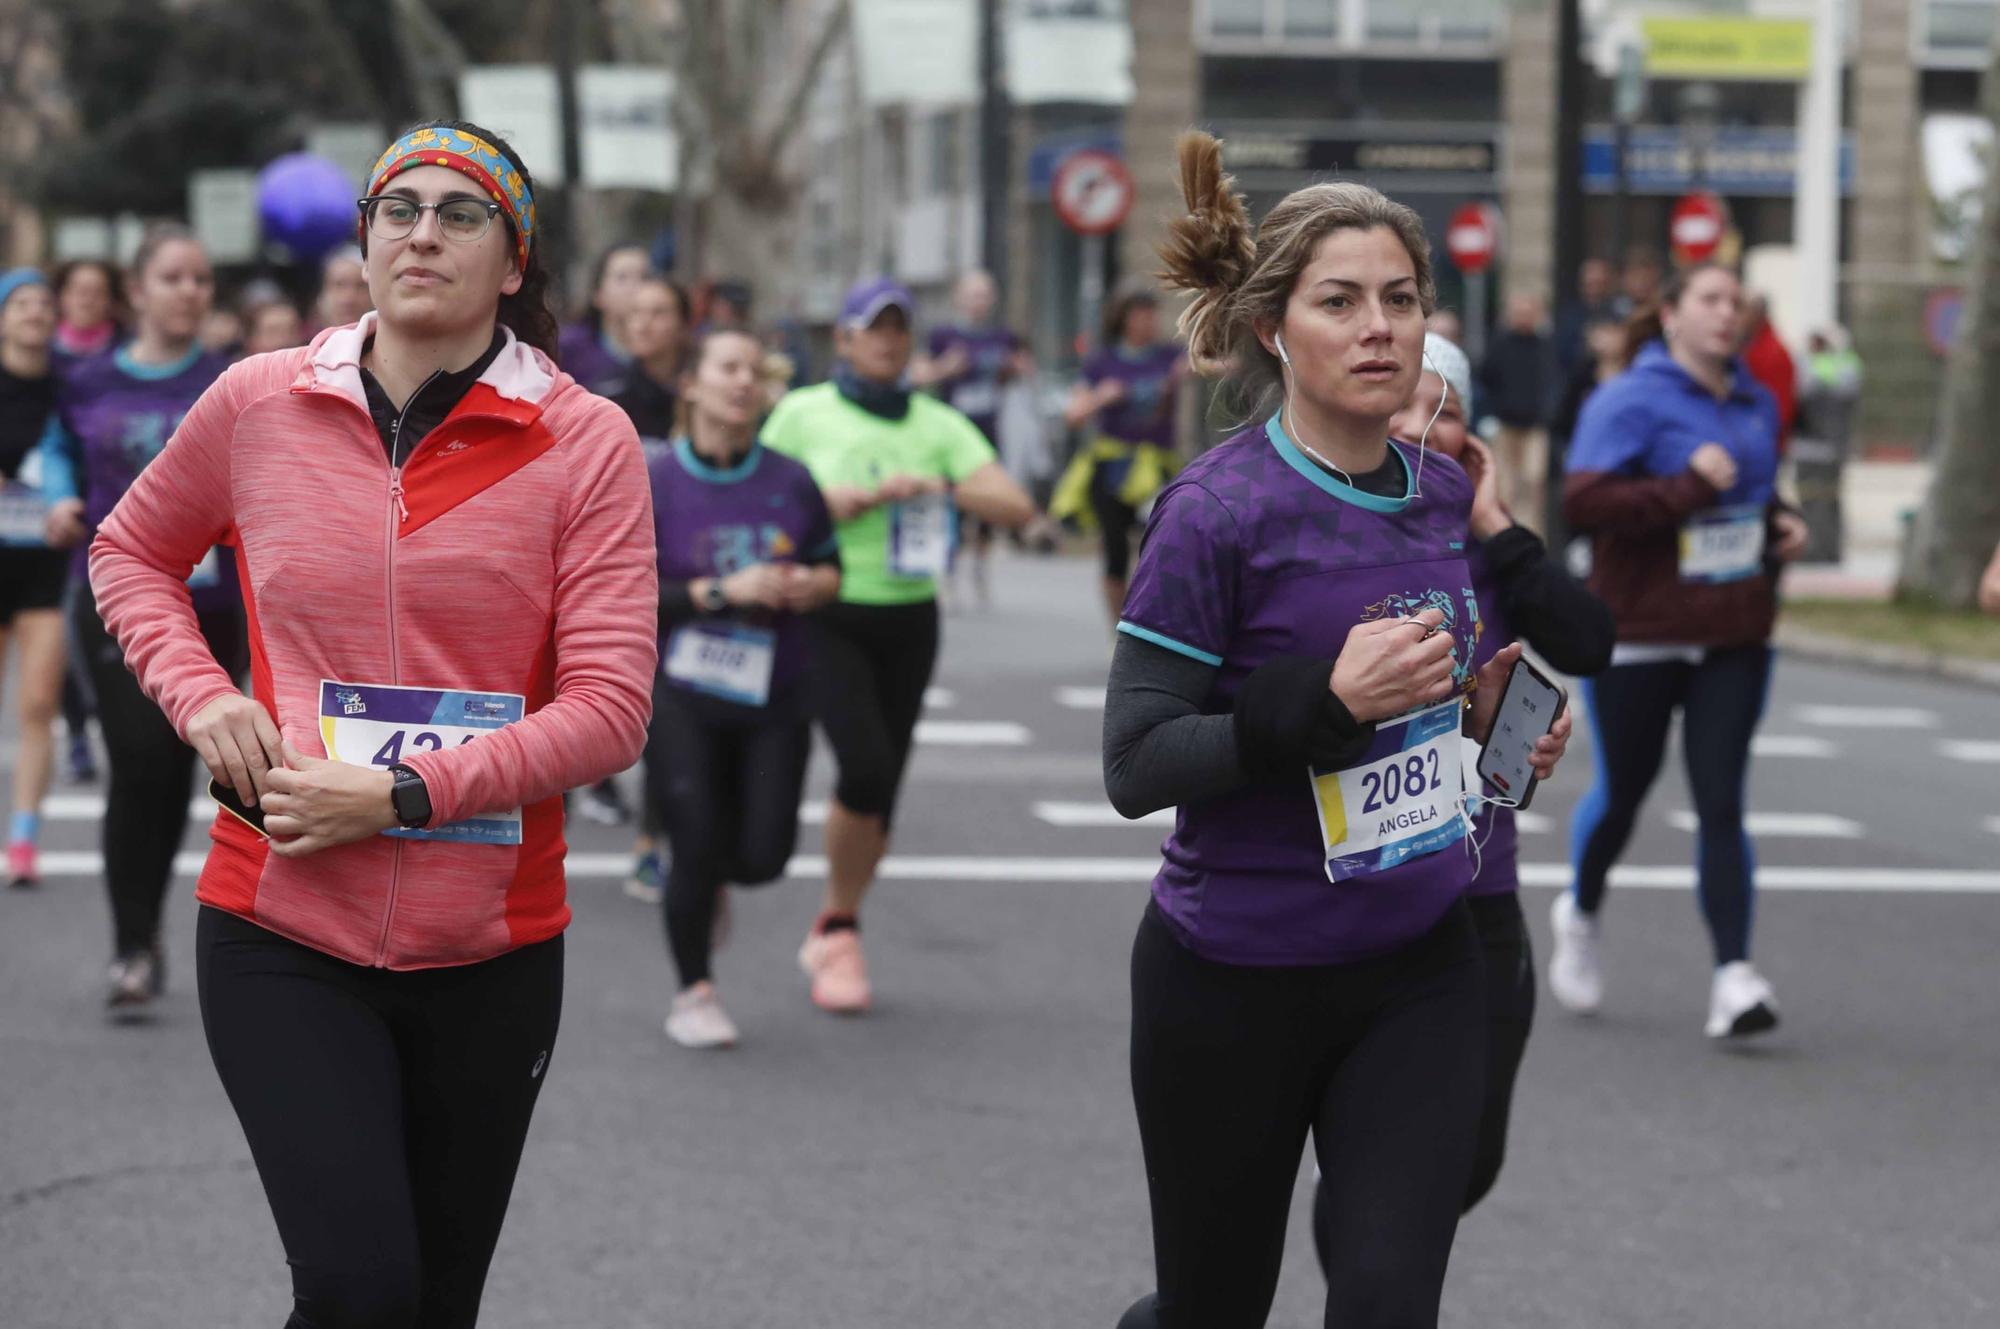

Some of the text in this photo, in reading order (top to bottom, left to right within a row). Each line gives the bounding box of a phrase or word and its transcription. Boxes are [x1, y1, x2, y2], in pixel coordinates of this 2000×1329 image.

[346, 703, 365, 713] FEM
[1361, 747, 1441, 814] 2082
[1378, 804, 1438, 837] ANGELA
